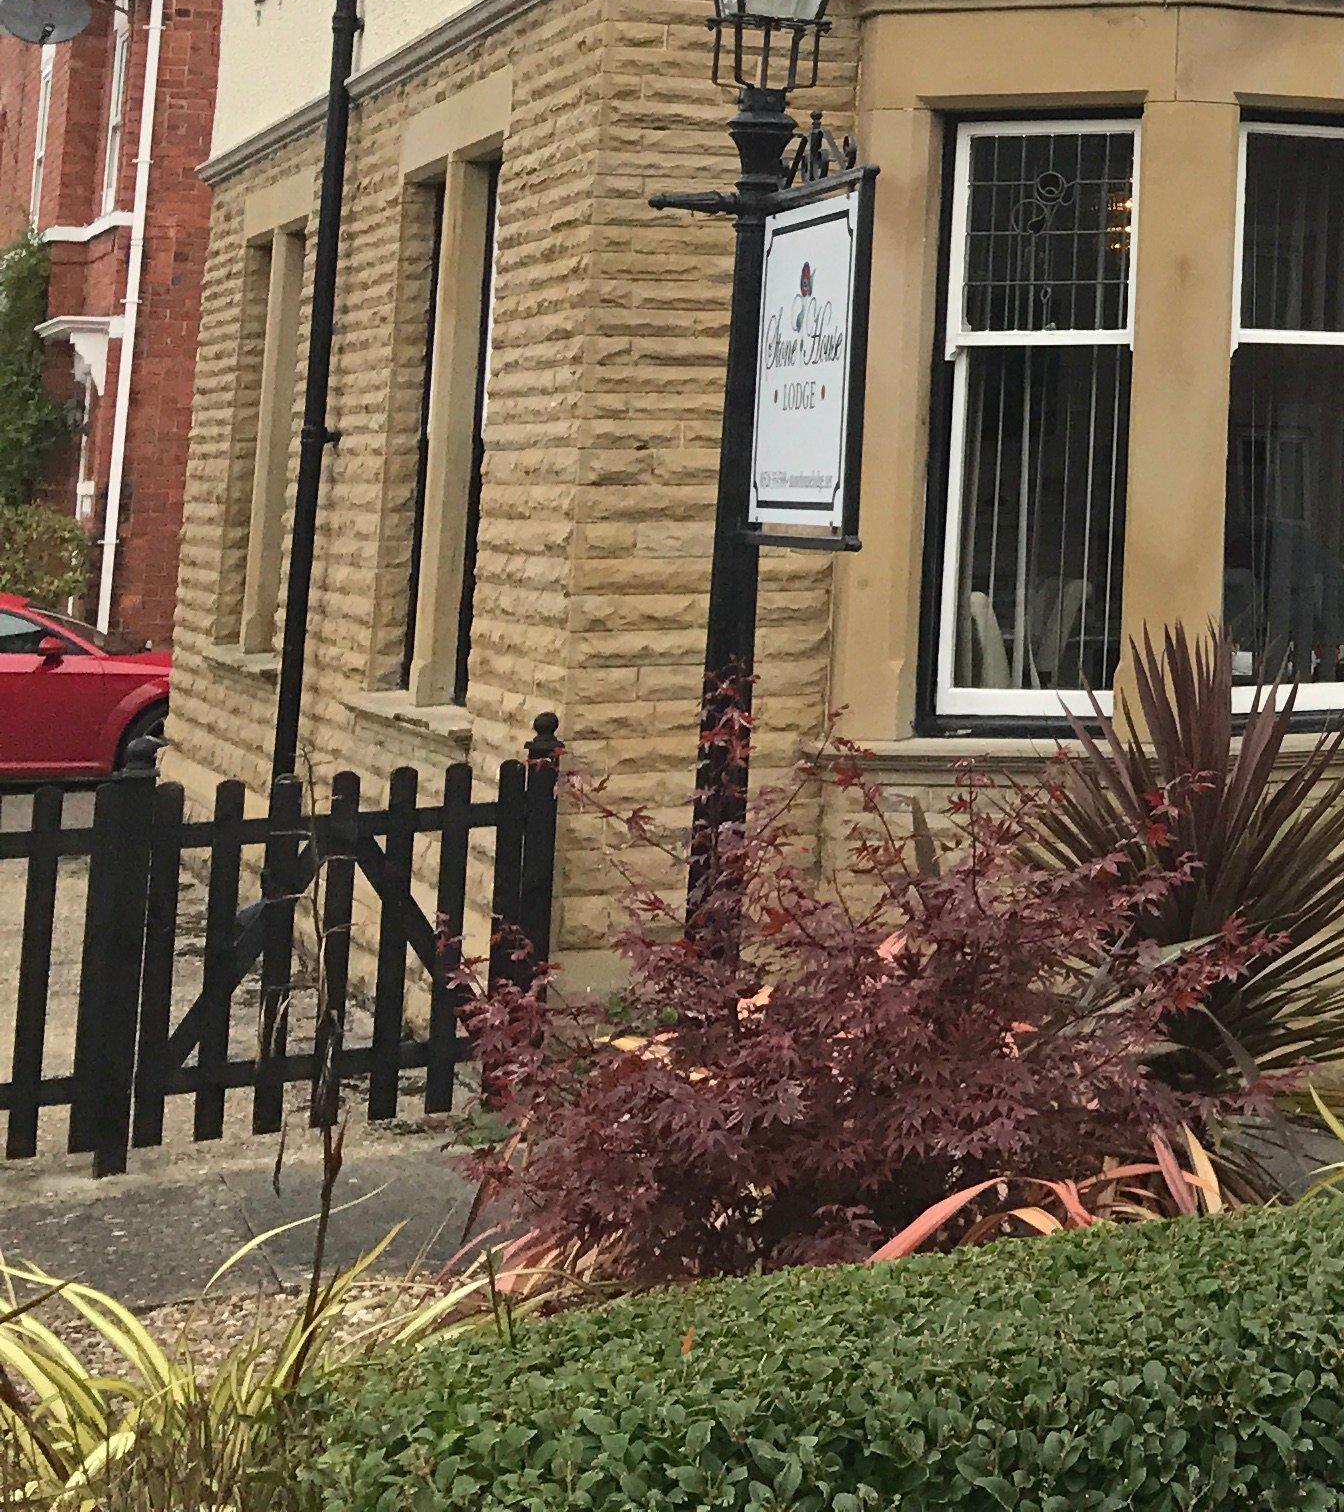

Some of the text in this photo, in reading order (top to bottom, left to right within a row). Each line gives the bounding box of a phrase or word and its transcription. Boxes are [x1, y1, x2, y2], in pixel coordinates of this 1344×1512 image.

[765, 297, 842, 369] Stone House
[782, 381, 816, 411] LODGE
